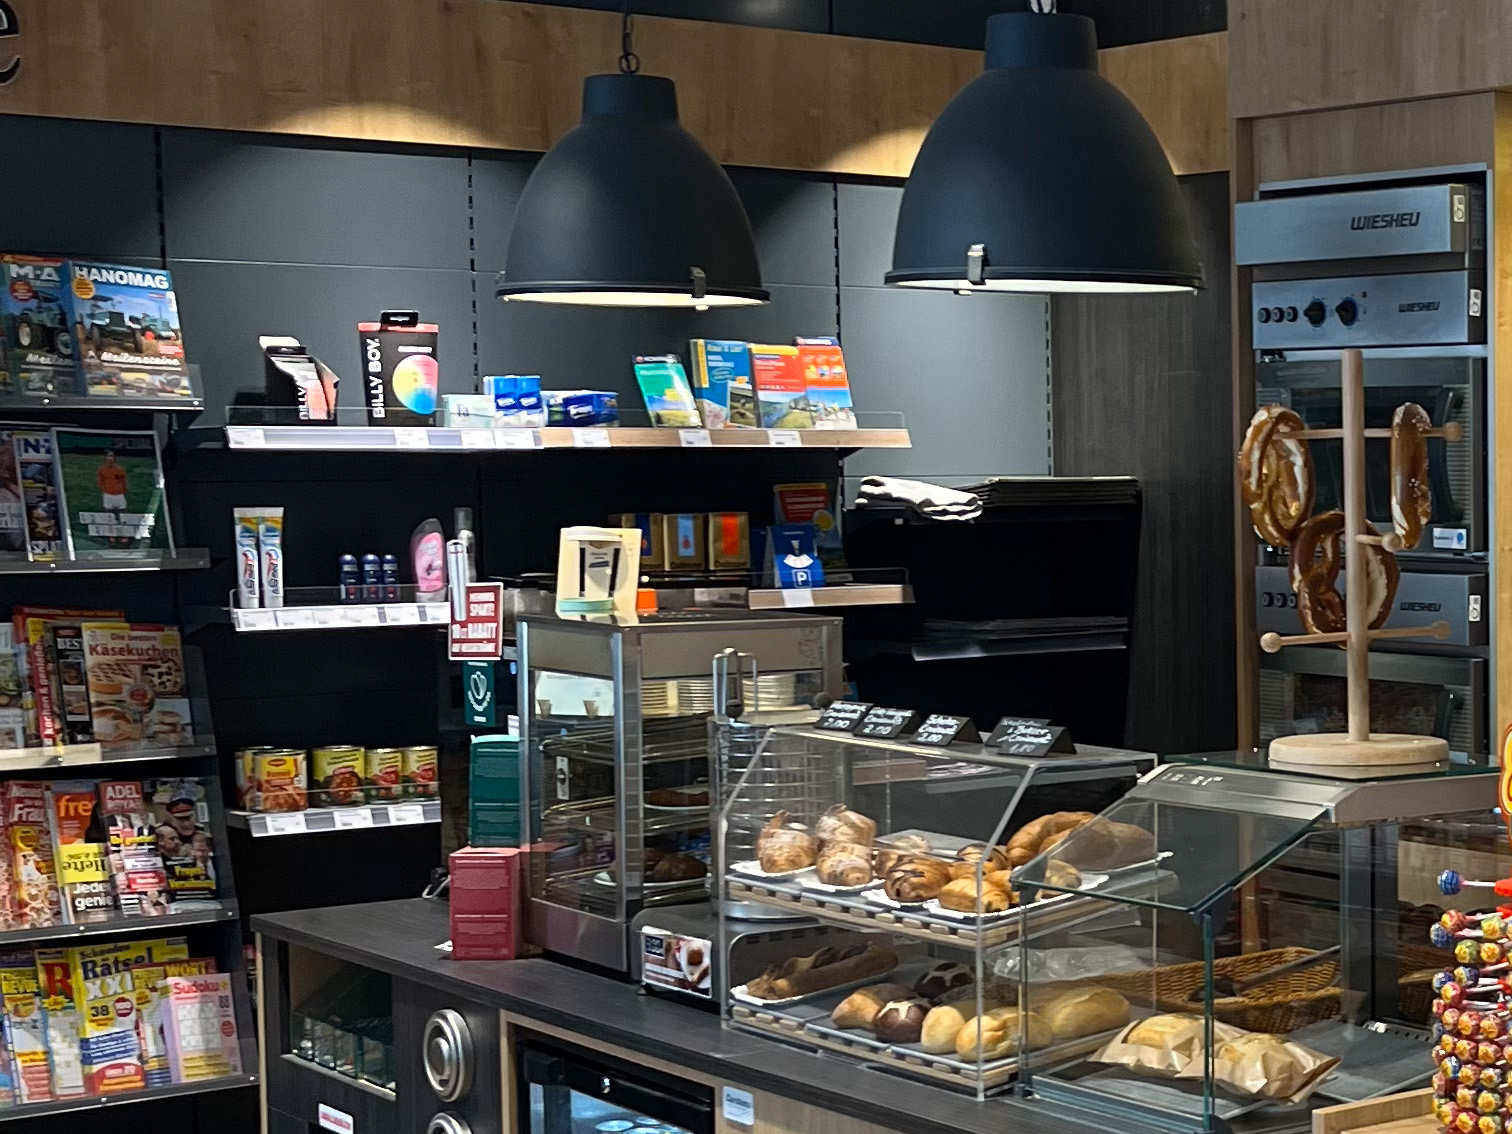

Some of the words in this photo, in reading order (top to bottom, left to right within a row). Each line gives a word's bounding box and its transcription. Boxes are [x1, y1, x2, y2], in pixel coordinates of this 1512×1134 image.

[1351, 212, 1421, 231] WIESHEU
[75, 266, 169, 290] HANOMAG
[370, 376, 386, 418] BILLY
[89, 643, 180, 658] Käsekuchen
[106, 784, 141, 799] ADEL
[173, 981, 219, 995] Sudoku
[90, 1003, 110, 1017] 38
